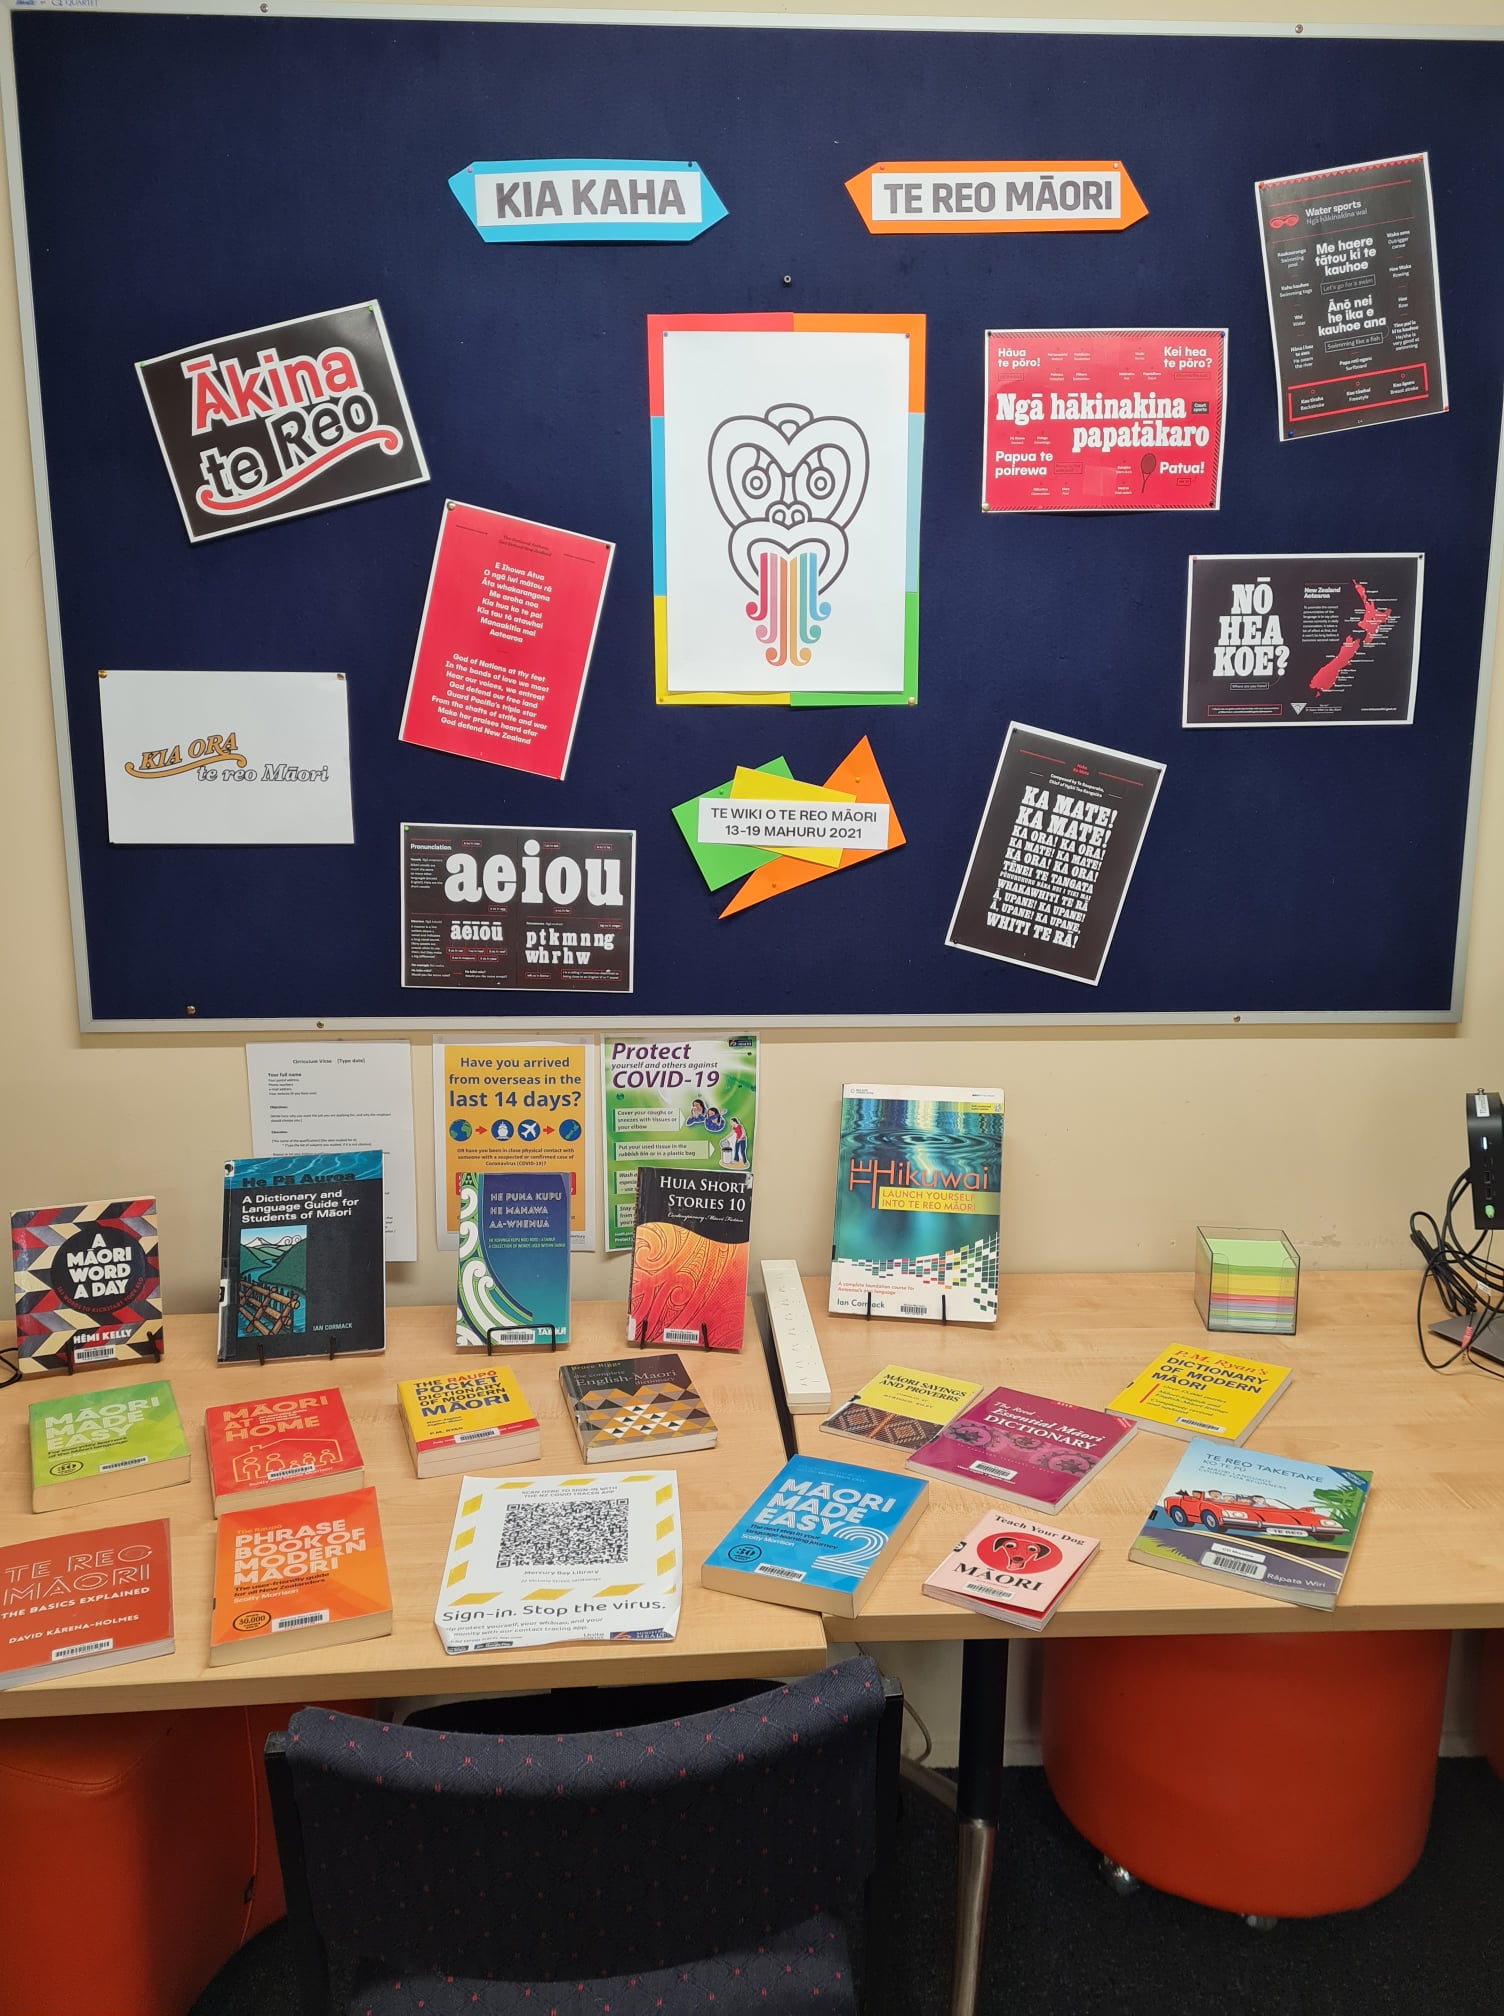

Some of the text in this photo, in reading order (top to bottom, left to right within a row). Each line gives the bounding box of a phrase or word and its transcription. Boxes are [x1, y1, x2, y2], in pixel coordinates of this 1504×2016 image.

[495, 179, 685, 219] KIA KAHA
[883, 175, 1112, 214] TE REO MĀORI
[1305, 200, 1361, 218] Water sports
[1316, 237, 1373, 255] Me haere
[1315, 248, 1376, 268] tātou ki te
[1325, 261, 1368, 277] kauhoe
[1328, 295, 1372, 312] Ānō nei
[1328, 308, 1374, 323] he ika e
[1318, 317, 1387, 337] kauhoe ana
[998, 348, 1026, 358] Hāua
[1164, 346, 1206, 357] Kei hea
[998, 358, 1040, 369] te pōro!
[1164, 357, 1212, 370] te pōro?
[186, 350, 358, 430] Ākina
[996, 392, 1187, 425] Ngā hākinakina
[200, 394, 374, 498] te Reo
[1072, 420, 1210, 453] papatākaro
[995, 451, 1053, 464] Papua te
[1159, 461, 1205, 474] Patua!
[995, 464, 1047, 478] poirewa
[502, 564, 525, 575] Ihowa
[527, 571, 545, 581] Atua
[1230, 576, 1273, 615] NŌ
[1218, 615, 1284, 646] HEA
[1213, 646, 1290, 677] KOE?
[441, 717, 531, 745] God defend New Zealand
[139, 732, 238, 770] KIA ORA
[197, 764, 329, 782] te reo Māori
[711, 807, 877, 822] TE WIKI O TE REO MĀORI
[1022, 785, 1118, 829] KA MATE!
[725, 825, 862, 839] 13-19 MAHURU 2021
[410, 843, 452, 851] Pronunciation
[987, 912, 1079, 949] WHITI TE RĀ!
[612, 1042, 691, 1060] Protect
[461, 1057, 570, 1070] Have you arrived
[612, 1062, 643, 1071] yourself
[689, 1062, 718, 1070] against
[449, 1074, 581, 1085] from overseas in the
[612, 1070, 720, 1088] COVID-19
[450, 1090, 581, 1112] last 14 days?
[660, 1176, 746, 1194] HUIA SHORT
[242, 1190, 342, 1204] A Dictionary and
[668, 1194, 746, 1212] STORIES 10
[882, 1190, 974, 1201] LAUNCH YOURSELF
[882, 1199, 976, 1212] INTO TE REO MĀORI
[242, 1198, 359, 1215] Language Guide for
[242, 1208, 352, 1223] Students of Māori
[91, 1233, 106, 1249] A
[66, 1247, 132, 1267] MĀORI
[69, 1263, 131, 1283] WORD
[74, 1279, 128, 1300] A DAY
[102, 1329, 132, 1340] KELLY
[1160, 1365, 1263, 1394] OF MODERN
[1166, 1357, 1269, 1385] DICTIONARY
[414, 1380, 441, 1388] THE
[416, 1376, 498, 1395] POCKET
[879, 1380, 961, 1402] AND PROVERBS
[920, 1382, 967, 1397] SAYINGS
[1152, 1372, 1208, 1391] MĀORI
[417, 1383, 502, 1401] DICTIONARY
[420, 1387, 506, 1407] OF MODERN
[223, 1396, 328, 1422] MĀORI
[421, 1394, 510, 1417] MĀORI
[224, 1418, 253, 1430] AT
[226, 1416, 320, 1442] HOME
[984, 1414, 1097, 1450] DICTIONARY
[992, 1408, 1106, 1442] Essential Māori
[1206, 1453, 1324, 1483] TE REO TAKETAKE
[779, 1478, 896, 1513] MĀORI
[766, 1493, 868, 1524] MADE
[235, 1519, 346, 1548] PHRASE
[995, 1515, 1085, 1546] Teach Your Dog
[235, 1528, 365, 1560] BOOK OF
[754, 1508, 889, 1579] EASY 2
[5, 1544, 153, 1584] TE REO
[235, 1539, 366, 1573] MODERN
[3, 1564, 150, 1606] MĀORI
[954, 1562, 1044, 1592] MĀORI
[1267, 1572, 1326, 1588] Rāpata Wiri
[442, 1600, 666, 1623] Sign-in. Stop the virus.
